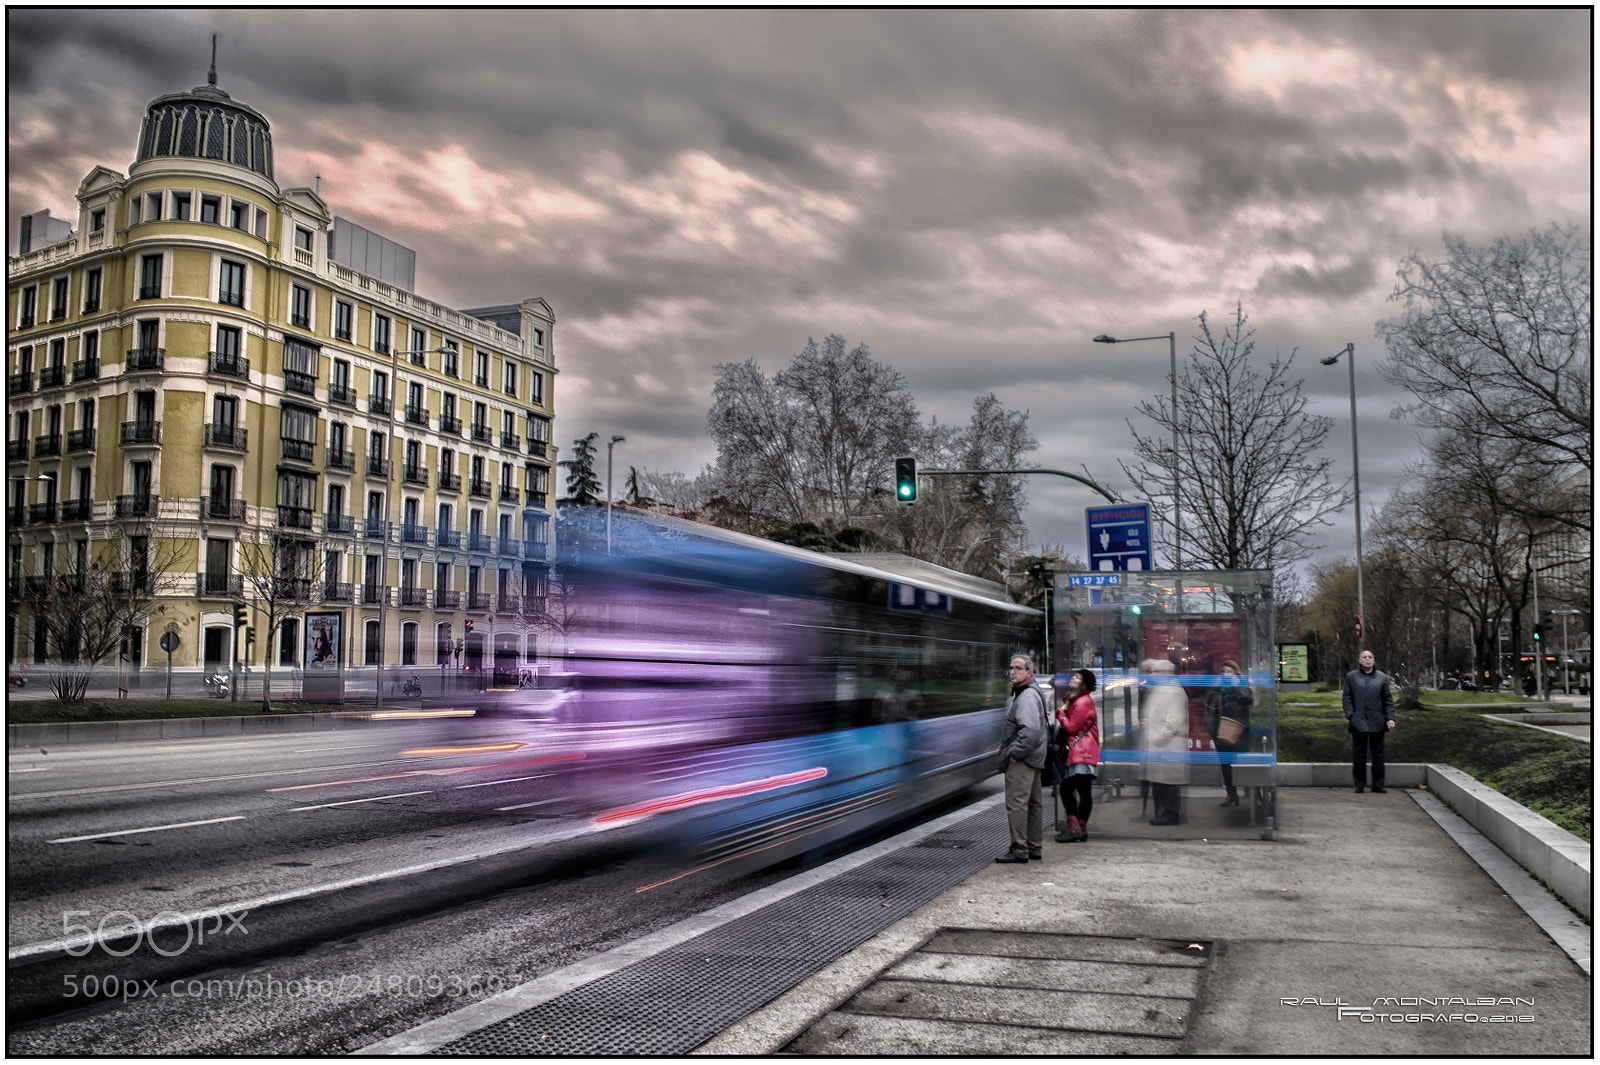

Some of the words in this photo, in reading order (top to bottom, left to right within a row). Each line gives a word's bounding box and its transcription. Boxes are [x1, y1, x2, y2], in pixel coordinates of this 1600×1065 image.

[1091, 509, 1145, 521] ATENCIÓN
[1071, 577, 1080, 585] 14
[1083, 576, 1092, 585] 27
[1095, 576, 1104, 584] 37
[1108, 575, 1118, 584] 45
